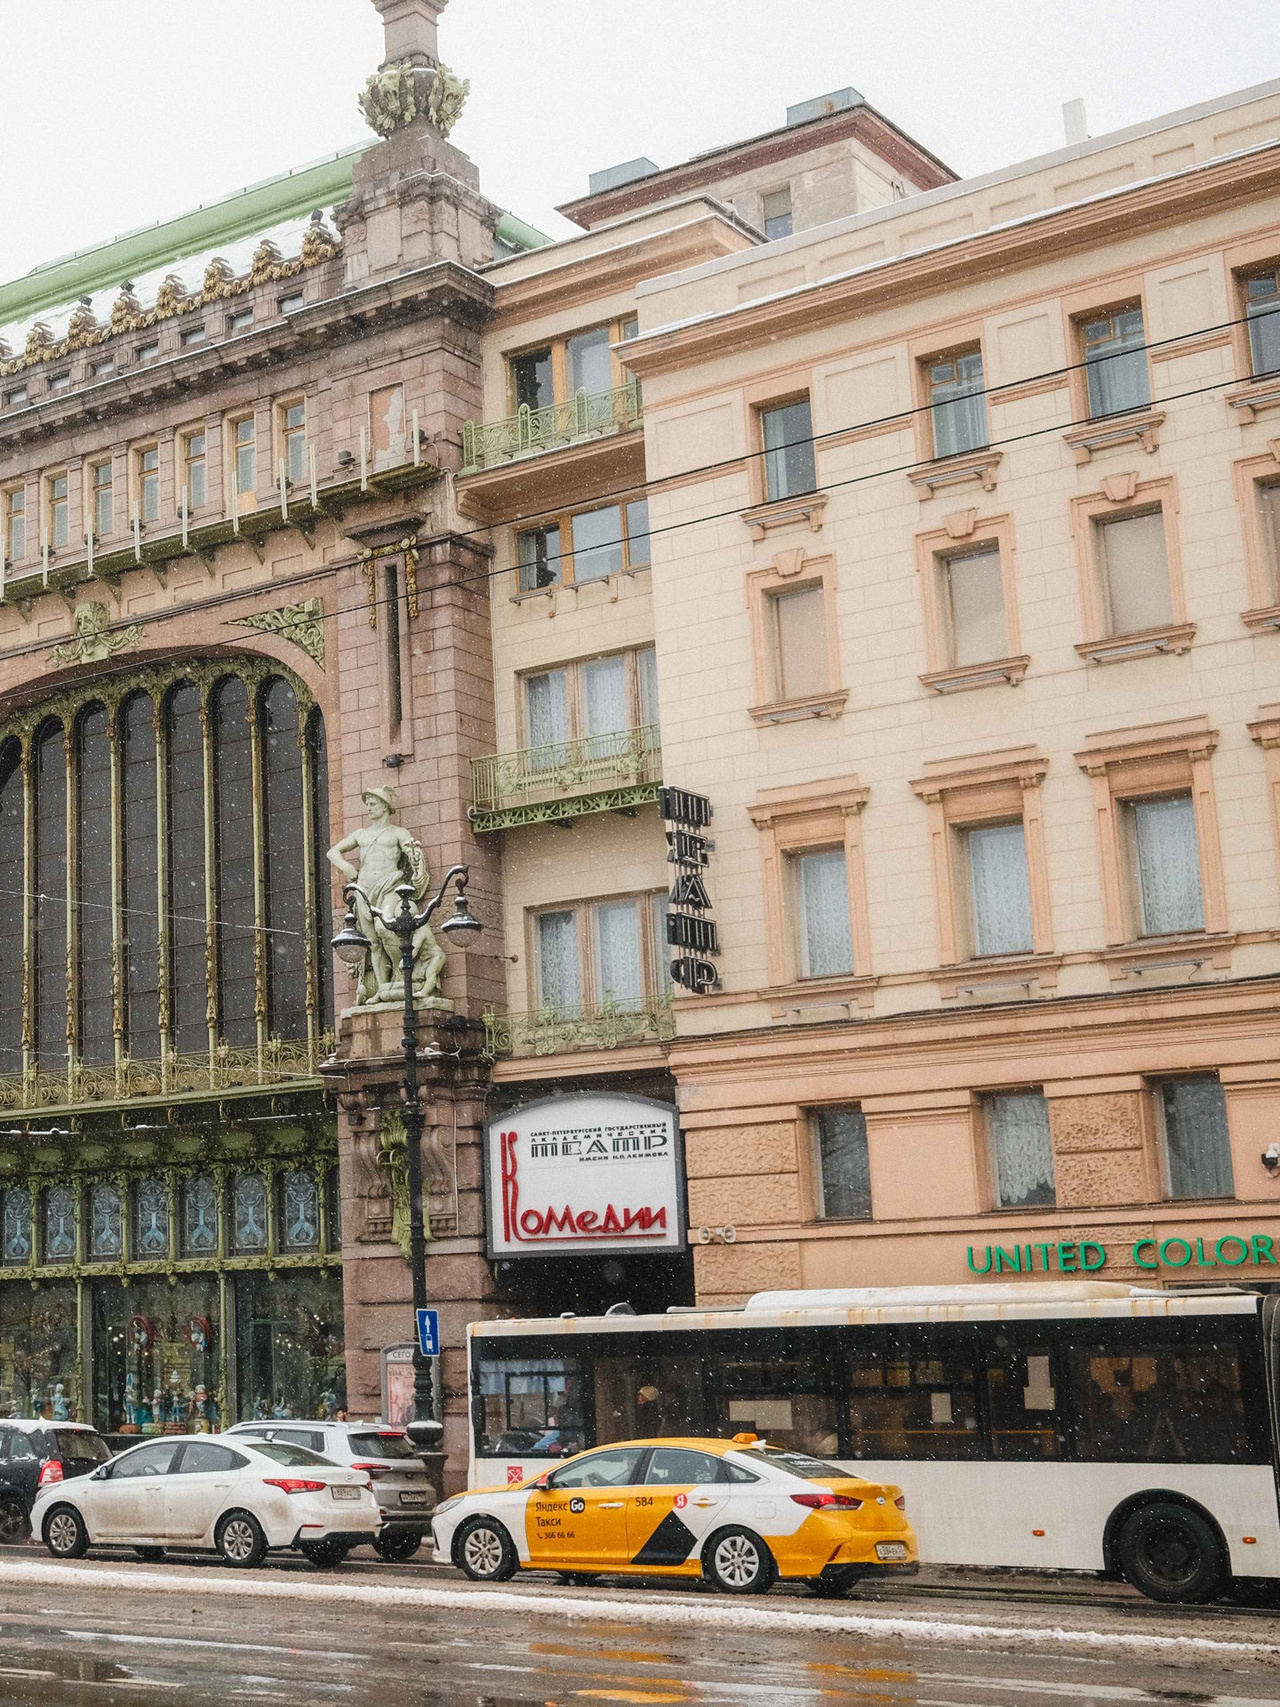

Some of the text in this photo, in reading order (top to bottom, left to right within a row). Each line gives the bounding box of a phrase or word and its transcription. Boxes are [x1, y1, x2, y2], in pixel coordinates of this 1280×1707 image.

[530, 1122, 667, 1136] САНКТ-ПЕТЕРБУРГСКИЙ ГОСУДАРСТВЕННЫЙ
[530, 1128, 667, 1143] АКАДЕМИЧЕСКИЙ
[531, 1135, 668, 1158] ТЕАТР
[966, 1240, 1107, 1274] UNITED
[570, 1499, 585, 1512] Go
[635, 1496, 653, 1507] 584
[676, 1495, 685, 1507] Я
[535, 1502, 568, 1513] Яндекс
[536, 1516, 562, 1527] Такси
[544, 1531, 575, 1540] 366 66 66
